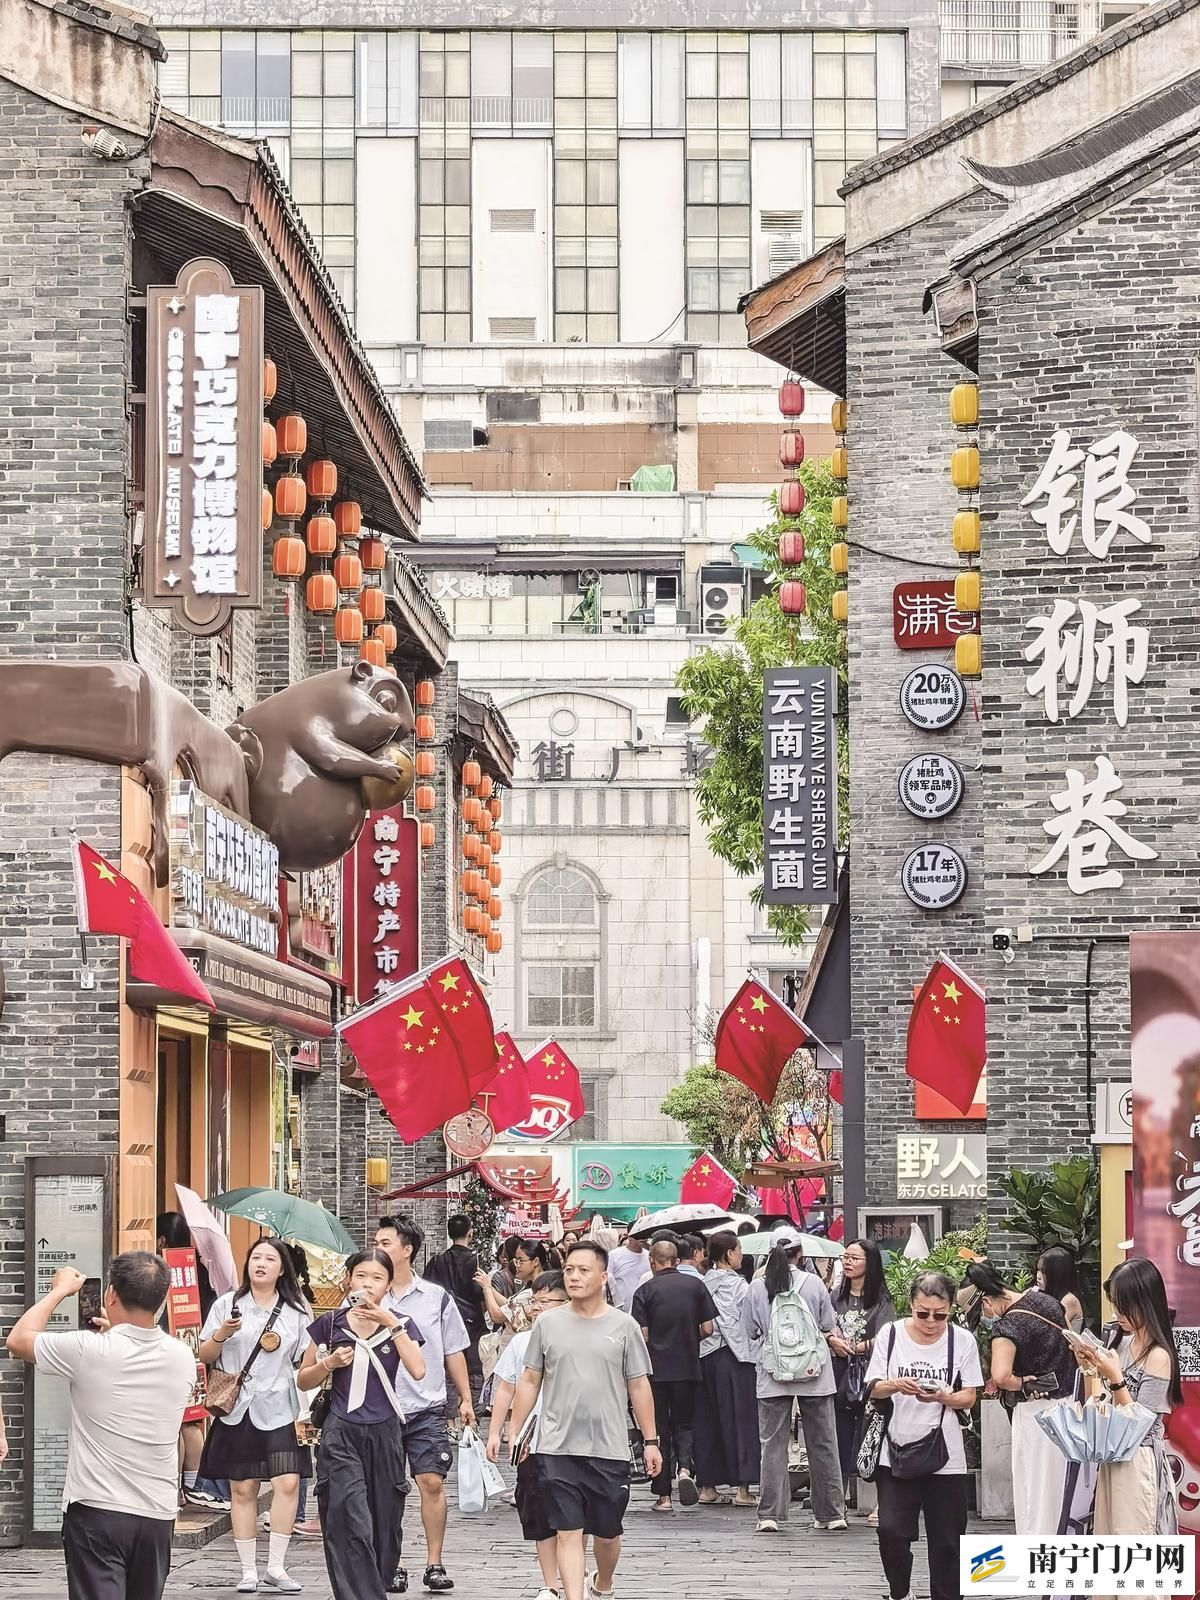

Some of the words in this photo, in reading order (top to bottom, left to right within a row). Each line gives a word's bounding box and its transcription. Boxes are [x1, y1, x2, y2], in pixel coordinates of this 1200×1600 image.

[189, 294, 240, 594] 南宁巧克力博物馆
[1020, 430, 1159, 895] 银狮巷
[811, 678, 826, 716] YUN
[811, 721, 826, 759] NAN
[811, 763, 826, 786] YE
[917, 768, 944, 777] 猪肚鸡
[921, 758, 939, 768] 广西
[768, 680, 806, 890] 云南野生菌
[909, 780, 952, 791] 领军品牌
[811, 789, 826, 849] SHENG
[811, 853, 827, 889] JUN
[898, 1137, 982, 1179] 野人
